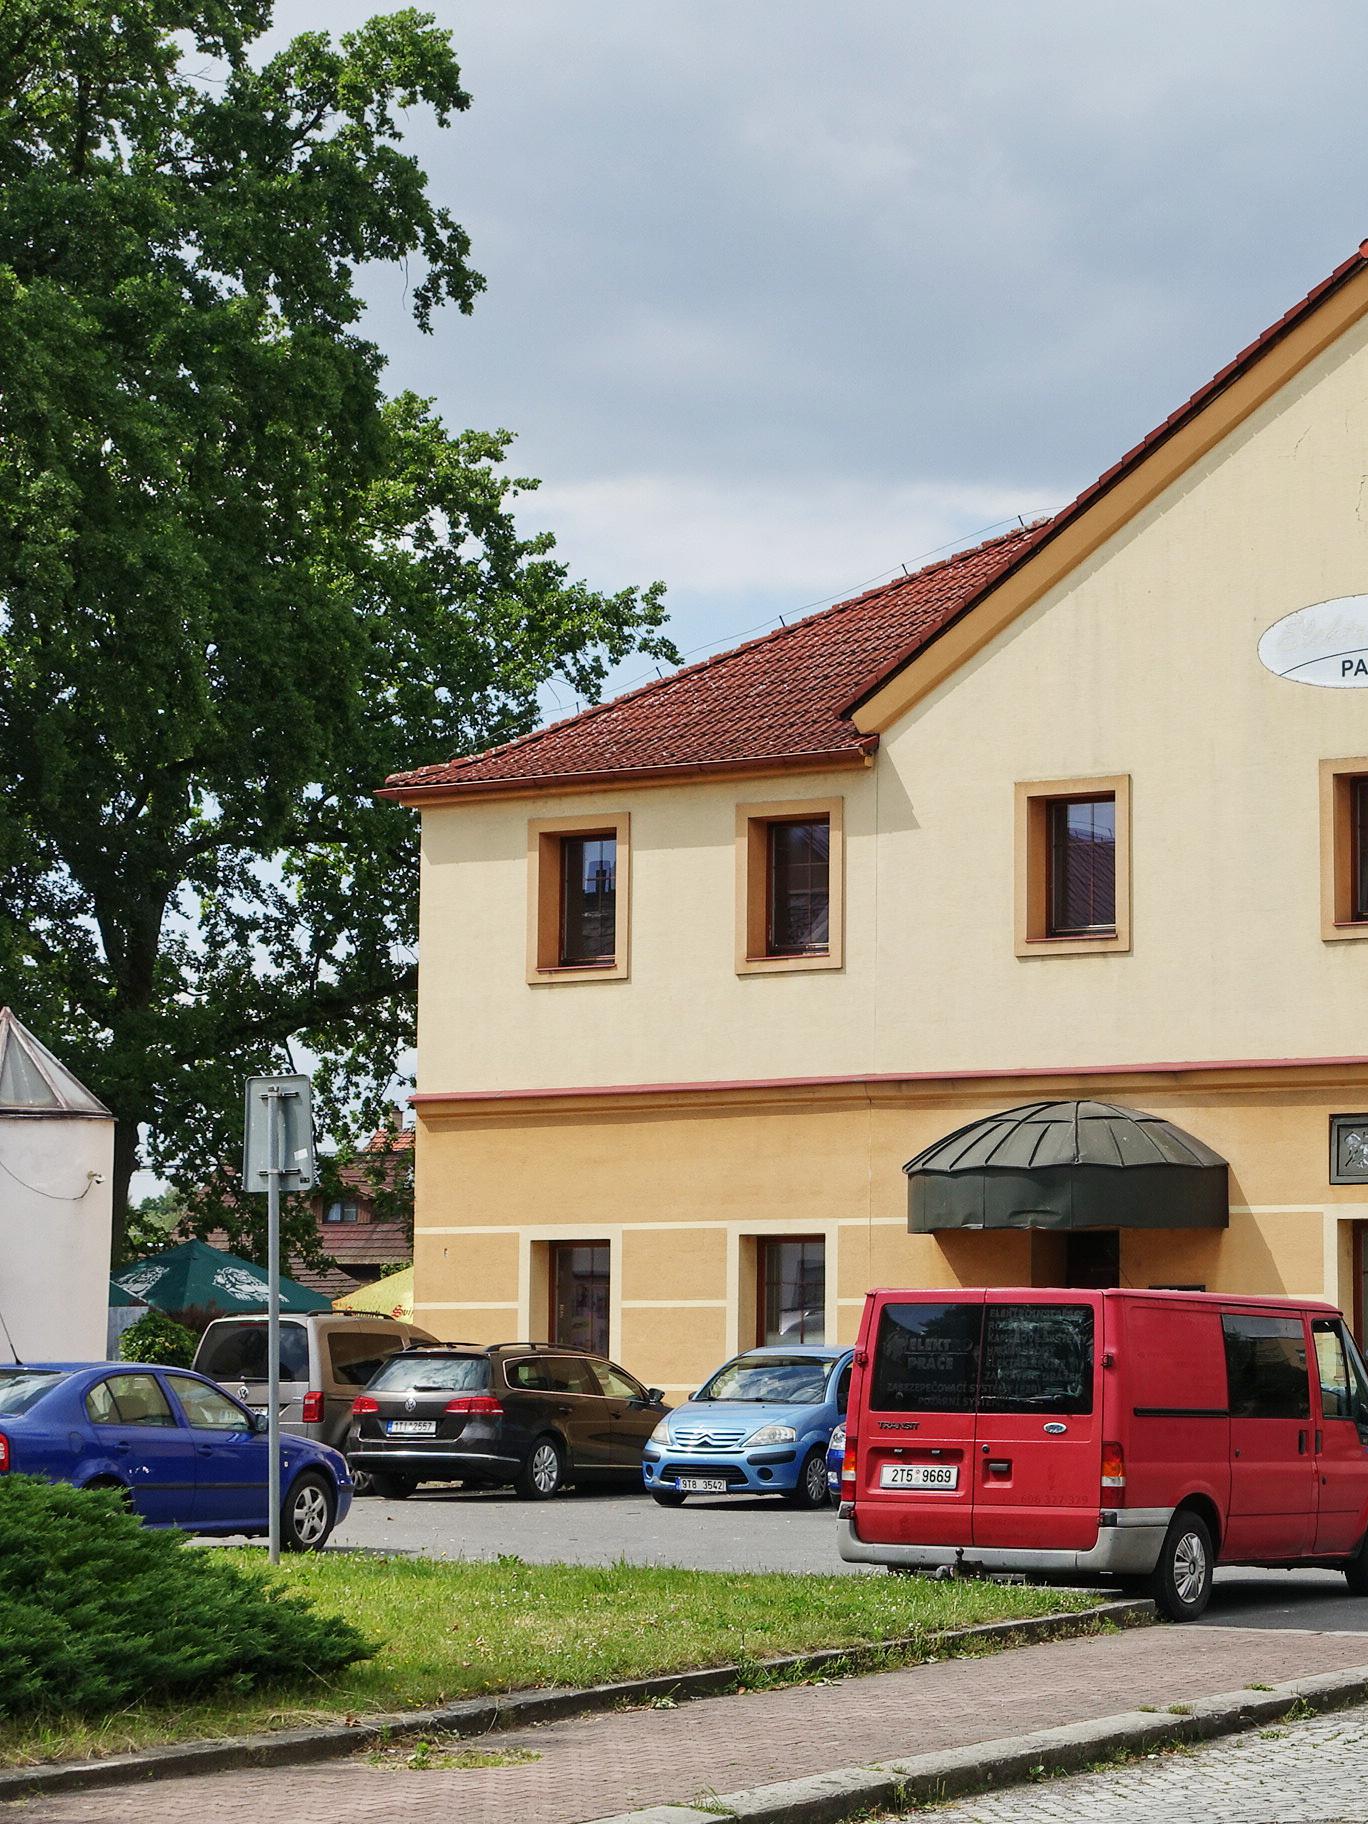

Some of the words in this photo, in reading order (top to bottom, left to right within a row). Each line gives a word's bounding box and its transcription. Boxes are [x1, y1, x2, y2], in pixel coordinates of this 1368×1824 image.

[891, 1469, 913, 1482] 2T5
[922, 1469, 951, 1483] 9669
[682, 1479, 696, 1489] 9T8
[702, 1480, 723, 1490] 3542
